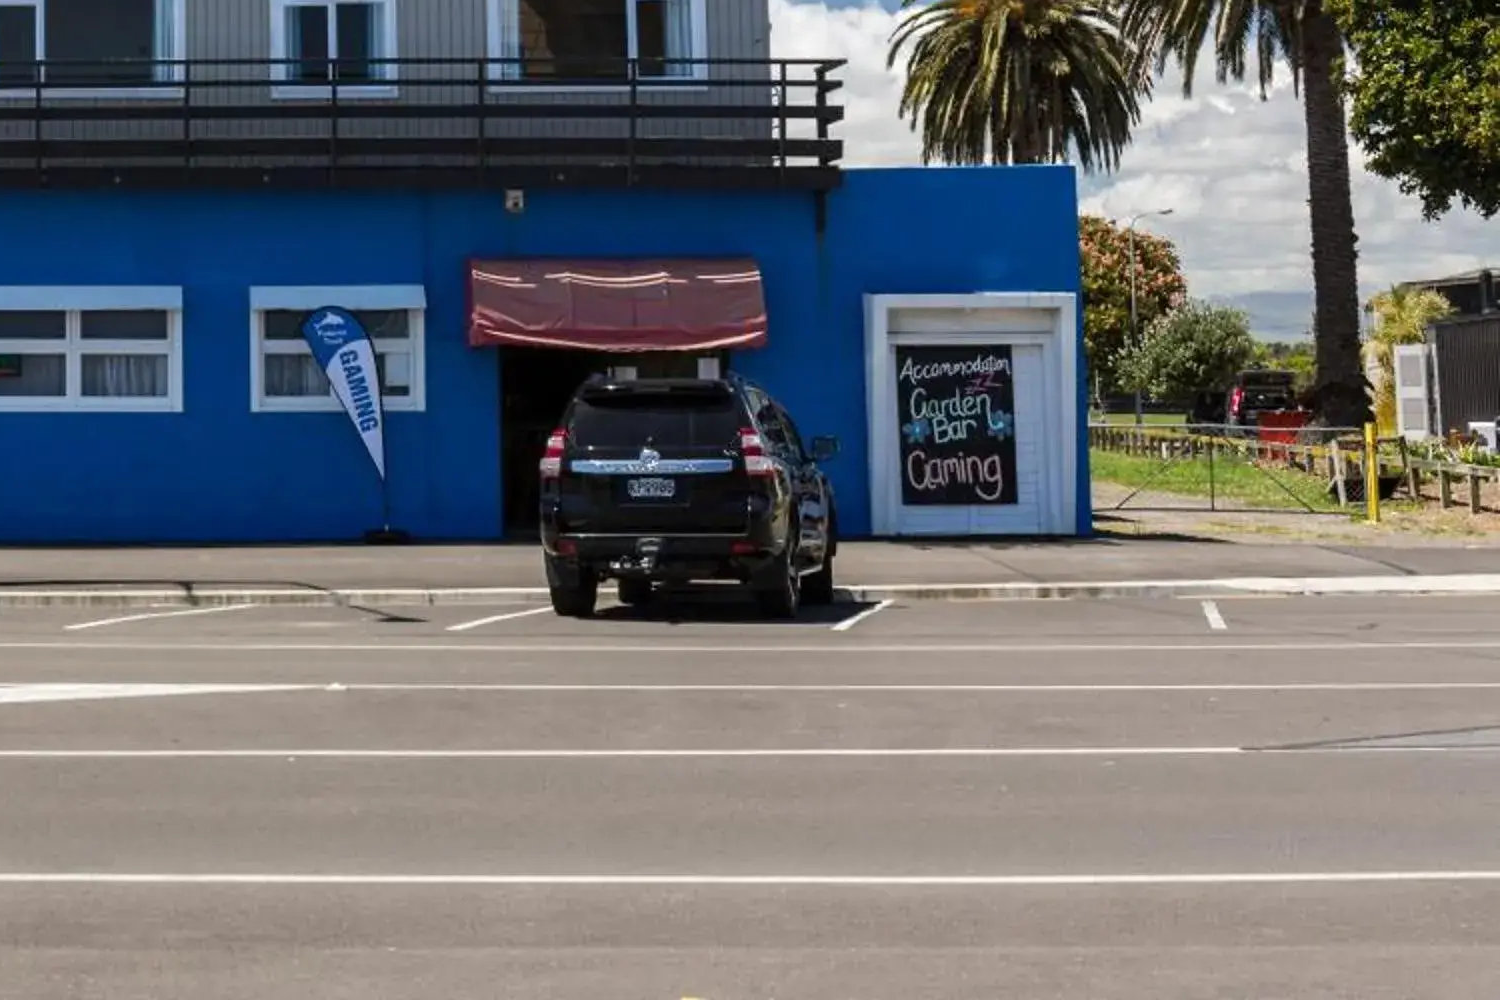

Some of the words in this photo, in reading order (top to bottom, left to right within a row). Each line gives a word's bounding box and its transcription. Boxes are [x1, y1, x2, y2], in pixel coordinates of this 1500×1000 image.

[899, 354, 1012, 385] Accommodation
[339, 349, 379, 433] GAMING
[910, 384, 1004, 430] Garden
[932, 415, 978, 444] Bar
